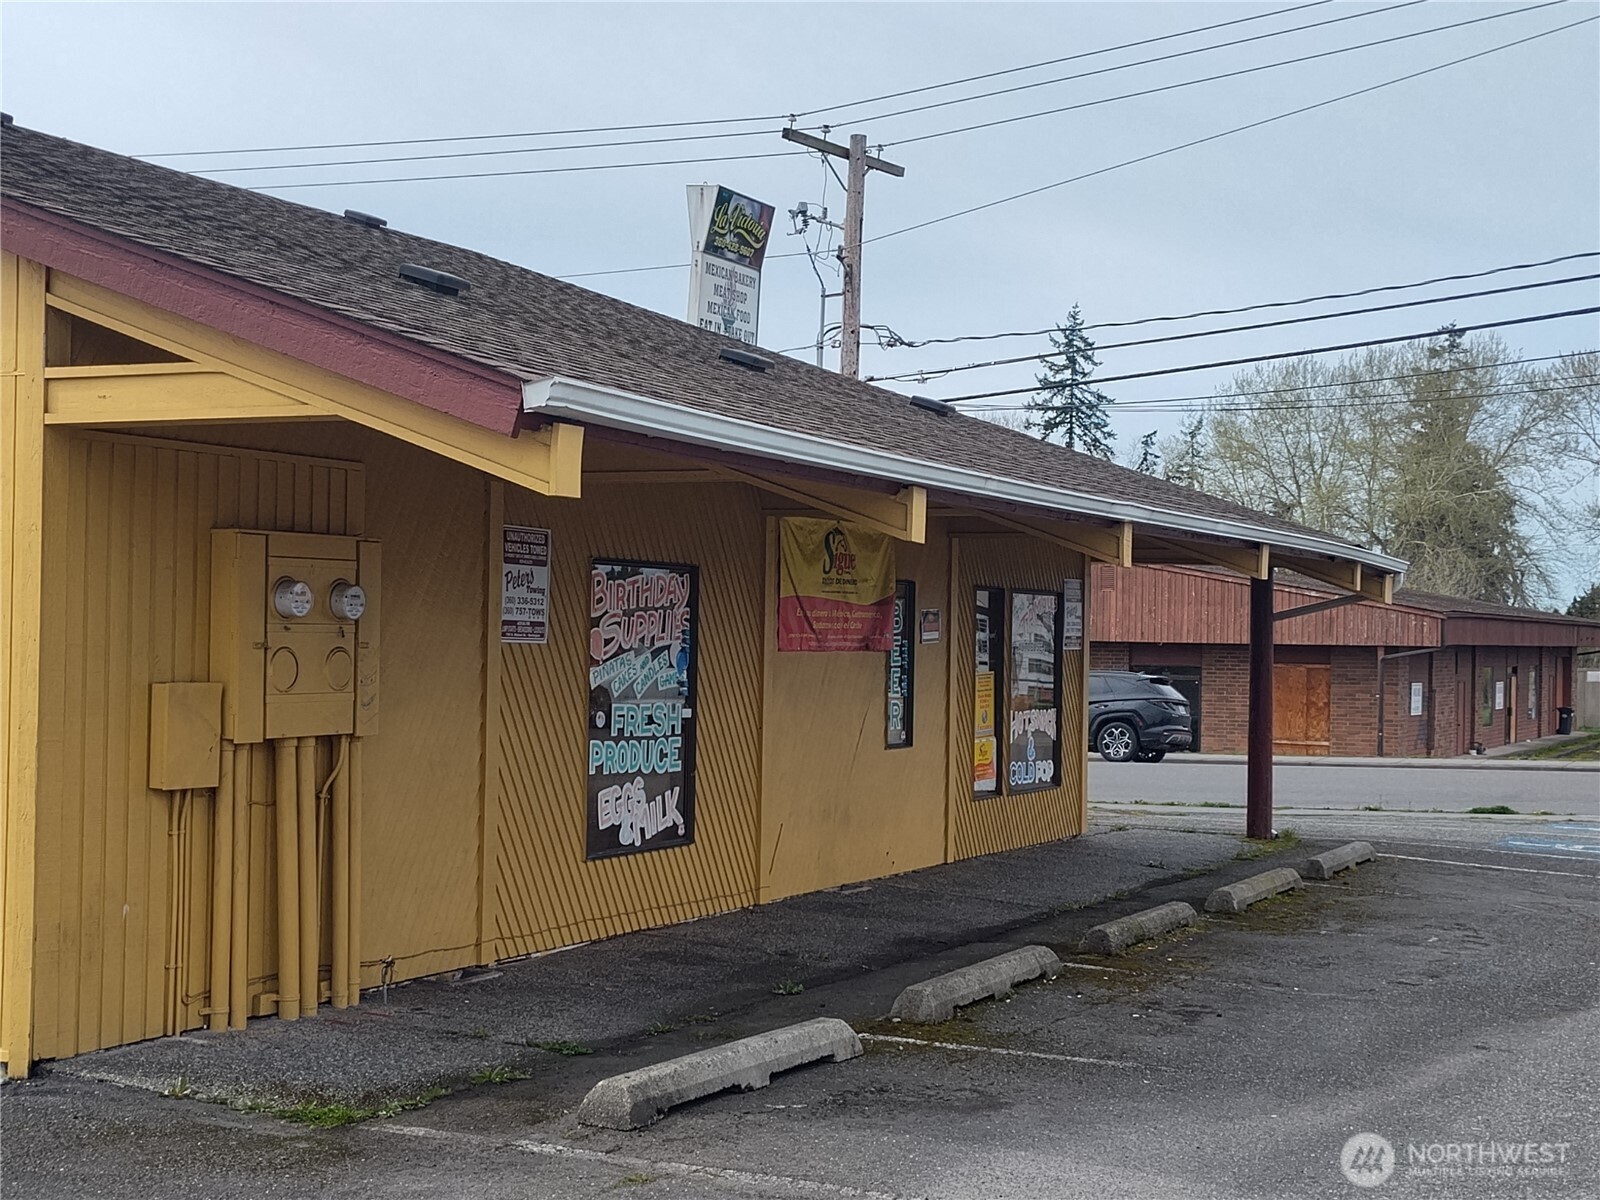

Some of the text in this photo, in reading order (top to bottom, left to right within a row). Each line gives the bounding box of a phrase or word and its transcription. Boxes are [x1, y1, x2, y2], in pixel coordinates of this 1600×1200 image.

[711, 203, 767, 242] La Victoria
[705, 261, 757, 290] MEXICAN BAKERY
[713, 283, 748, 305] MEAT SHOP
[706, 300, 751, 324] MEXICAN FOOD
[700, 318, 755, 344] EAT IN TAKE OUT
[504, 542, 547, 556] VEHICLES TOWED
[506, 531, 546, 544] UNAUTHORIZED
[822, 526, 856, 575] Sigue
[517, 597, 545, 607] 336-5312
[526, 585, 545, 596] Towing
[591, 570, 690, 618] BIRTHDAY
[515, 607, 545, 617] 757-TOWS
[612, 655, 650, 693] CAKES AND
[635, 653, 668, 695] CANDLES
[610, 702, 682, 737] FRESH
[1010, 710, 1030, 745] HOT
[589, 737, 682, 775] PRODUCE
[1009, 761, 1035, 786] COLD
[1035, 760, 1054, 784] POP
[597, 776, 647, 830] EGGS
[632, 786, 684, 846] MILK
